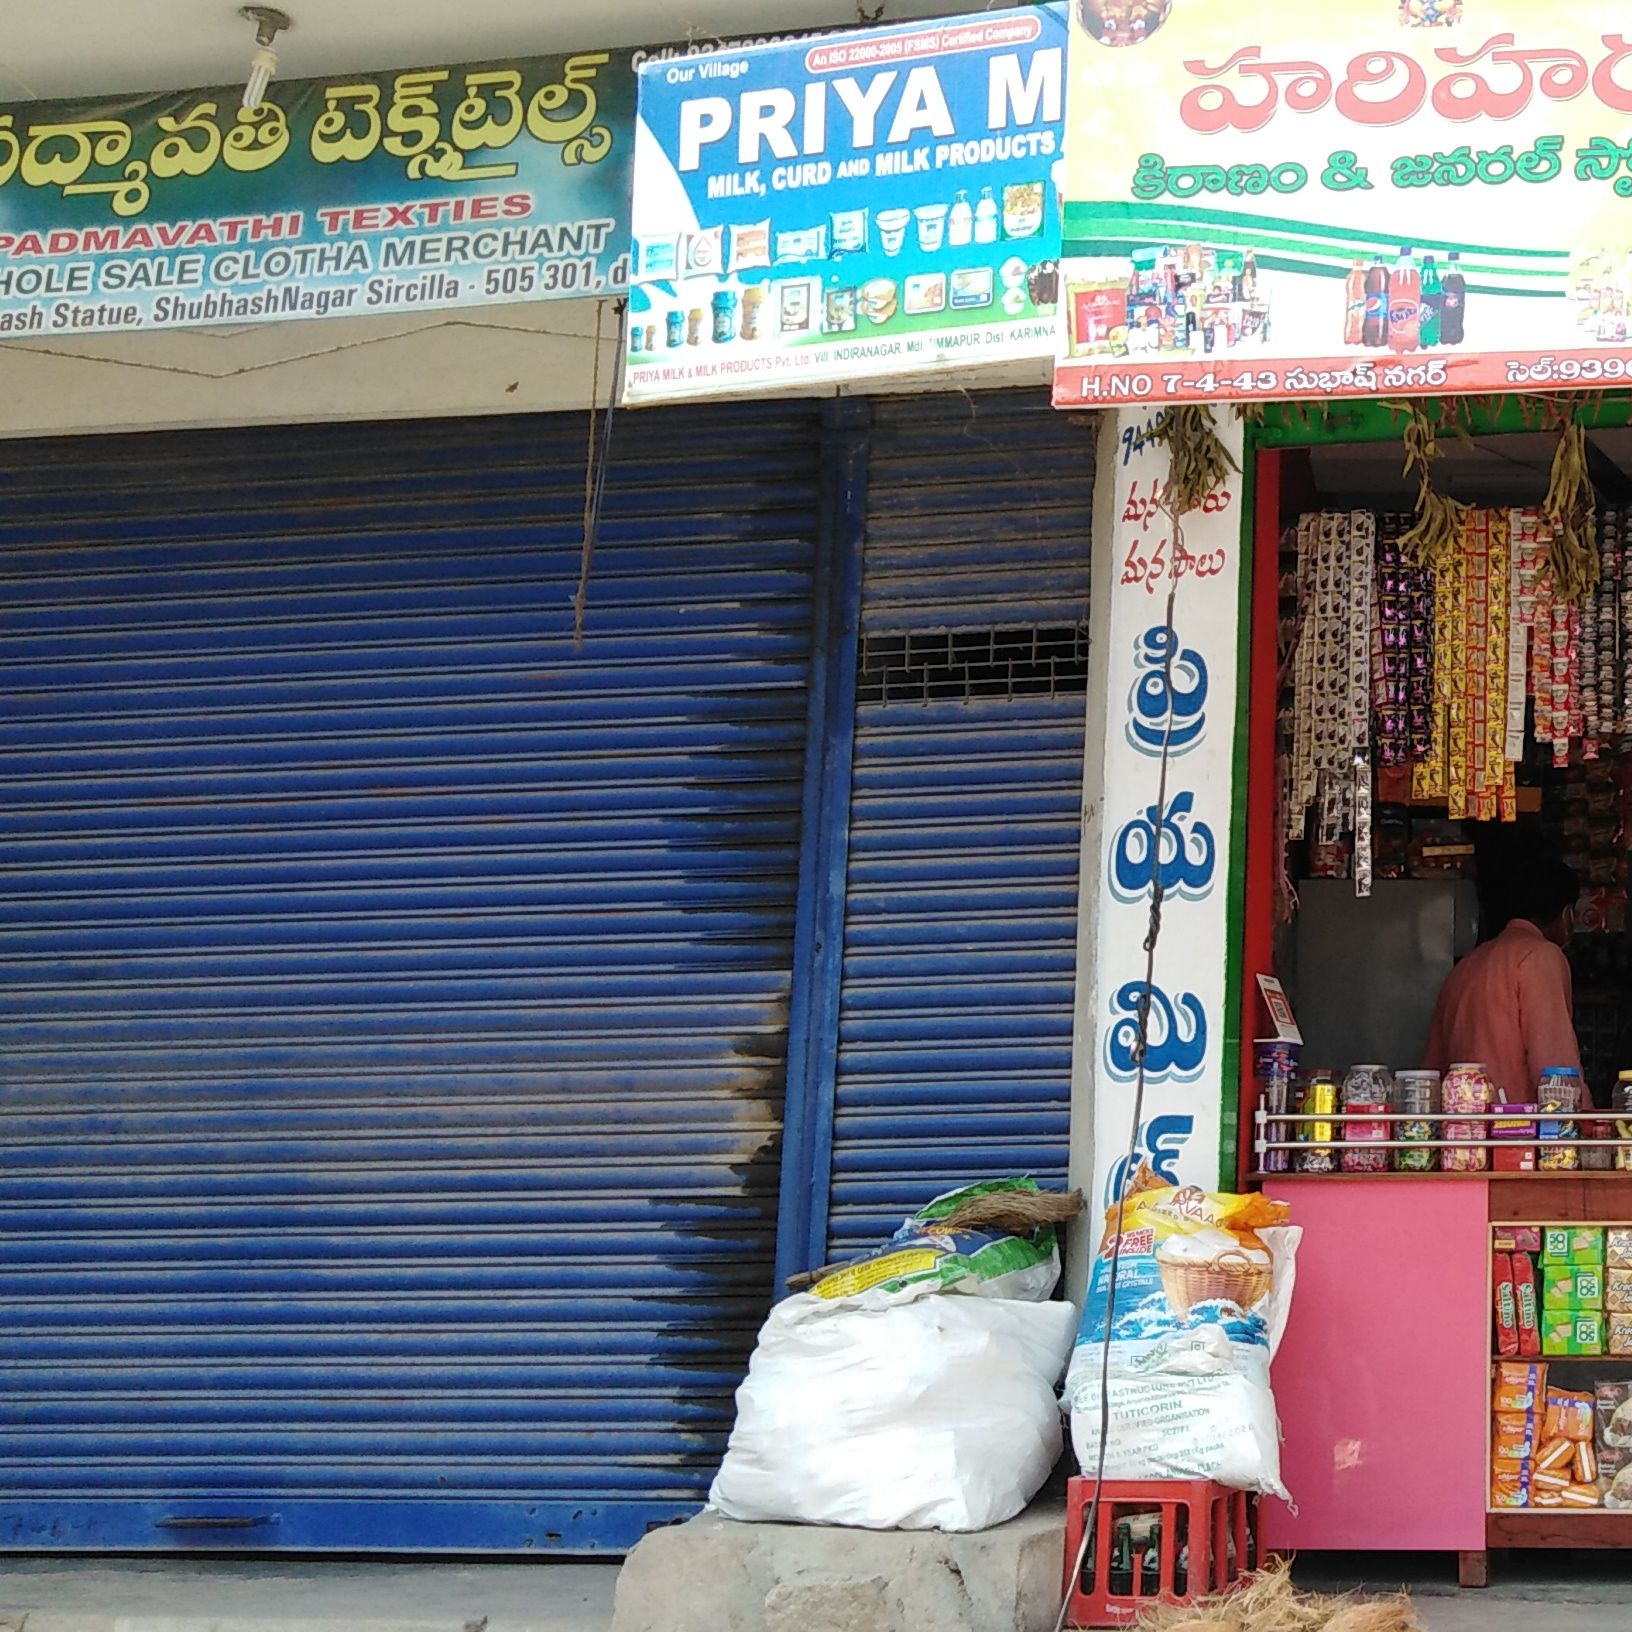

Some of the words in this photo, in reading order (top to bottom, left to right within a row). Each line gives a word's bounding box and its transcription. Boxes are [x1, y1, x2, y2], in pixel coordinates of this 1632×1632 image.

[813, 54, 827, 66] An
[829, 51, 845, 63] ISO
[941, 31, 983, 48] Certified
[985, 24, 1032, 43] Company
[666, 66, 695, 84] Our
[699, 59, 749, 80] Village
[679, 65, 955, 172] PRIYA
[707, 168, 767, 199] MILK,
[772, 160, 831, 190] CURD
[837, 158, 870, 180] AND
[875, 147, 930, 178] MILK
[935, 131, 1056, 167] PRODUCTS
[1131, 154, 1309, 200] కిరాణం
[1321, 151, 1374, 188] &
[1391, 135, 1563, 188] జనరల్
[319, 194, 532, 232] TEXTIES
[102, 258, 201, 290] SALE
[213, 244, 369, 284] CLOTHA
[383, 223, 611, 268] MERCHANT
[52, 303, 143, 328] Statue,
[367, 274, 459, 305] Sircilla
[486, 266, 534, 296] 505
[544, 261, 602, 291] 301,
[633, 369, 660, 384] PRIYA
[662, 366, 684, 381] MILK
[695, 362, 718, 377] MILK
[720, 356, 772, 375] PRODUCTS
[834, 341, 901, 361] INDIRANAGAR
[1081, 374, 1152, 398] H.NO
[1162, 371, 1277, 393] 7-4-43
[1284, 360, 1379, 392] సుభాష్
[1383, 359, 1447, 387] నగర్
[1123, 1234, 1153, 1247] FREE
[1112, 1400, 1183, 1421] TUTICORIN
